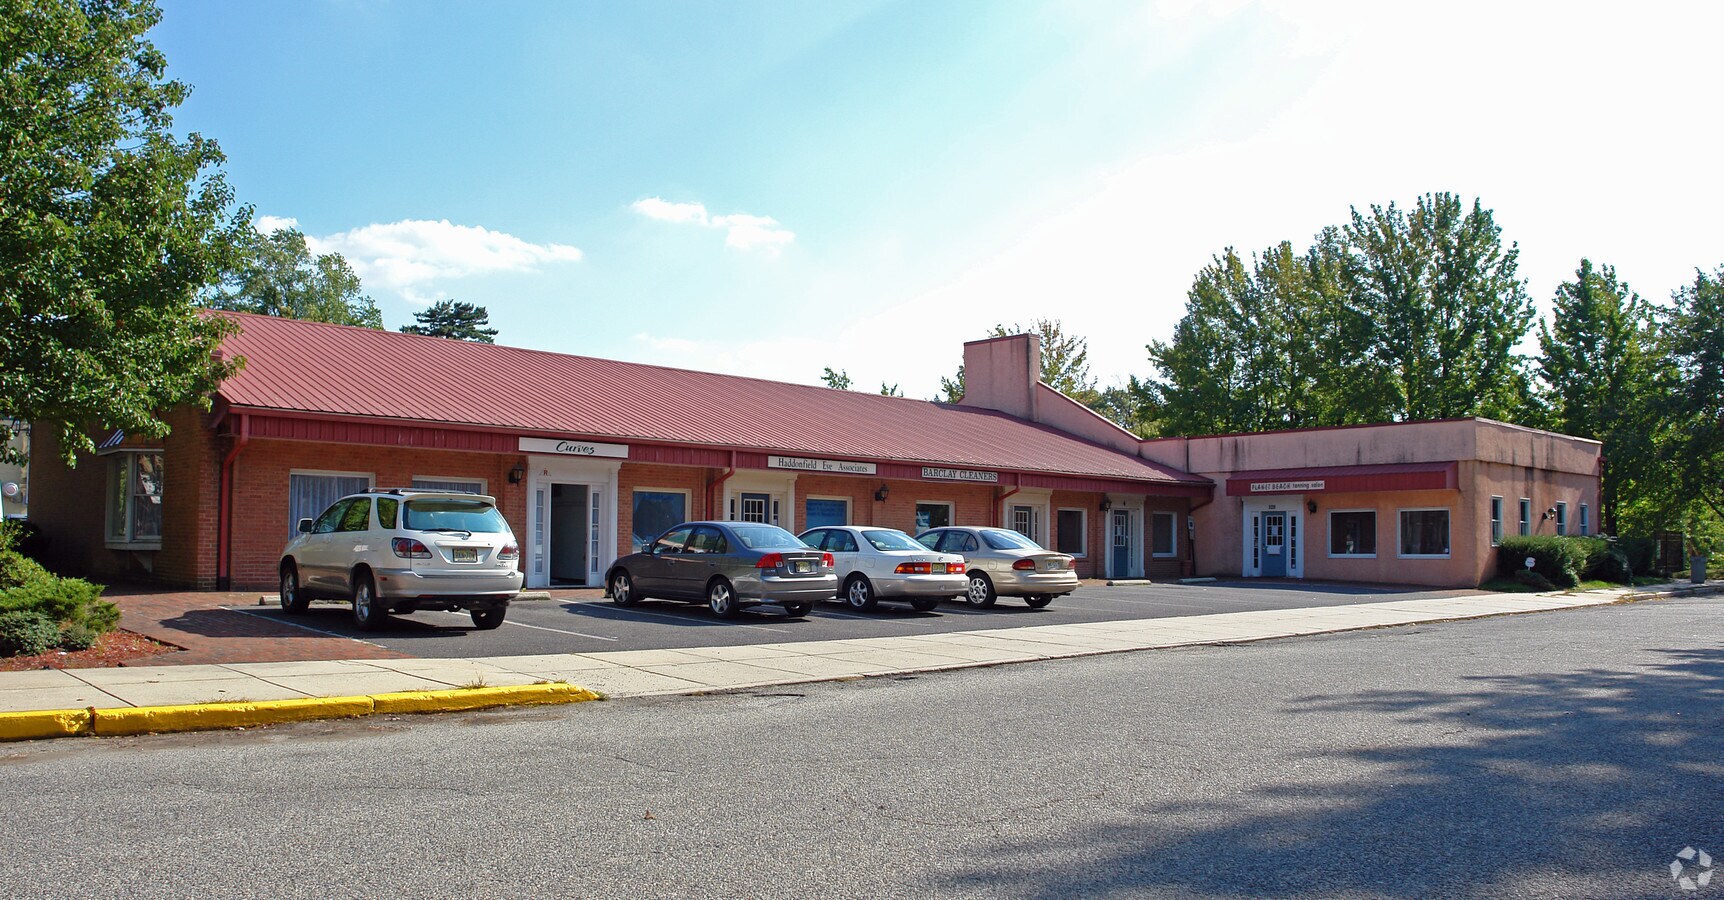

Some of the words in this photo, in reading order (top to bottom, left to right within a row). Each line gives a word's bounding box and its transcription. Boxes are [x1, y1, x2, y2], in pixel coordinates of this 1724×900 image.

[555, 441, 595, 455] Curves
[778, 457, 817, 469] Haddonfield
[822, 461, 833, 471] Eye
[838, 463, 868, 473] Associates
[923, 467, 957, 478] BARCLAY
[960, 470, 997, 481] CLEANERS
[1292, 482, 1310, 490] tanning
